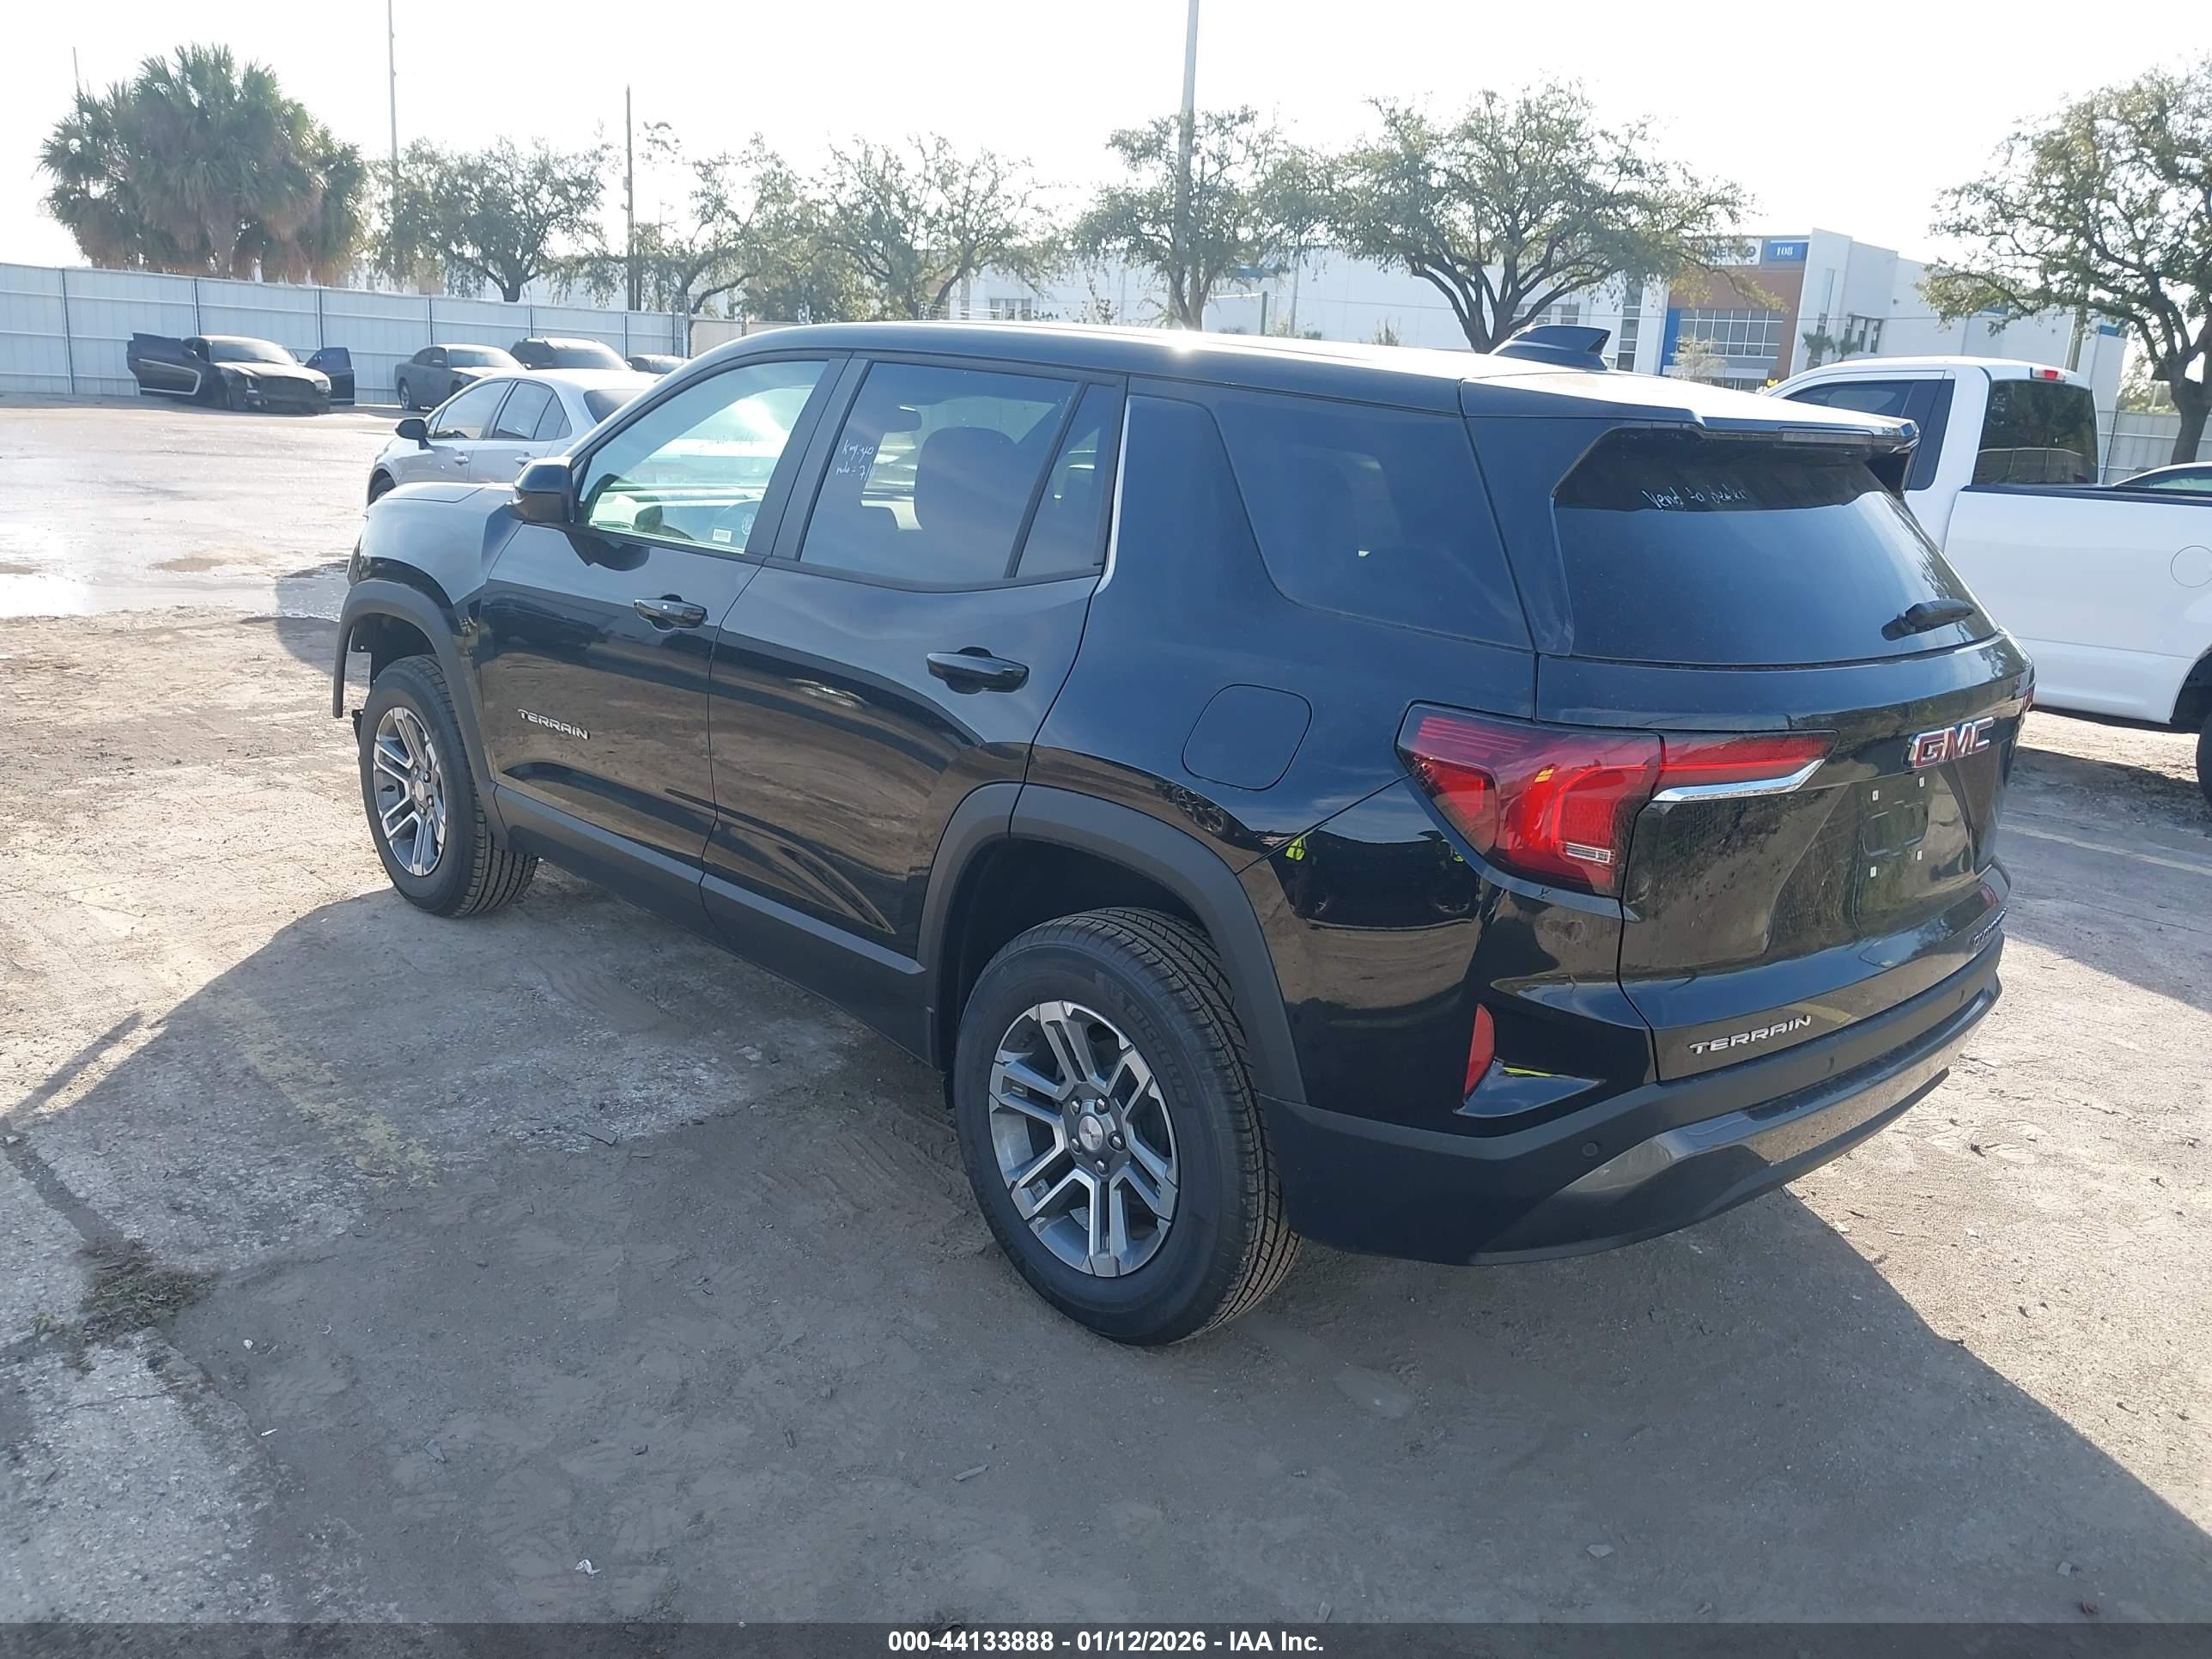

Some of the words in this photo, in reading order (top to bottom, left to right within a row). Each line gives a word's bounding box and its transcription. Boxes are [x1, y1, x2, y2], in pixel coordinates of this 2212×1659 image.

[517, 708, 590, 740] TERRAIN
[1908, 716, 1995, 769] GMC
[1689, 1015, 1812, 1054] TERRAIN
